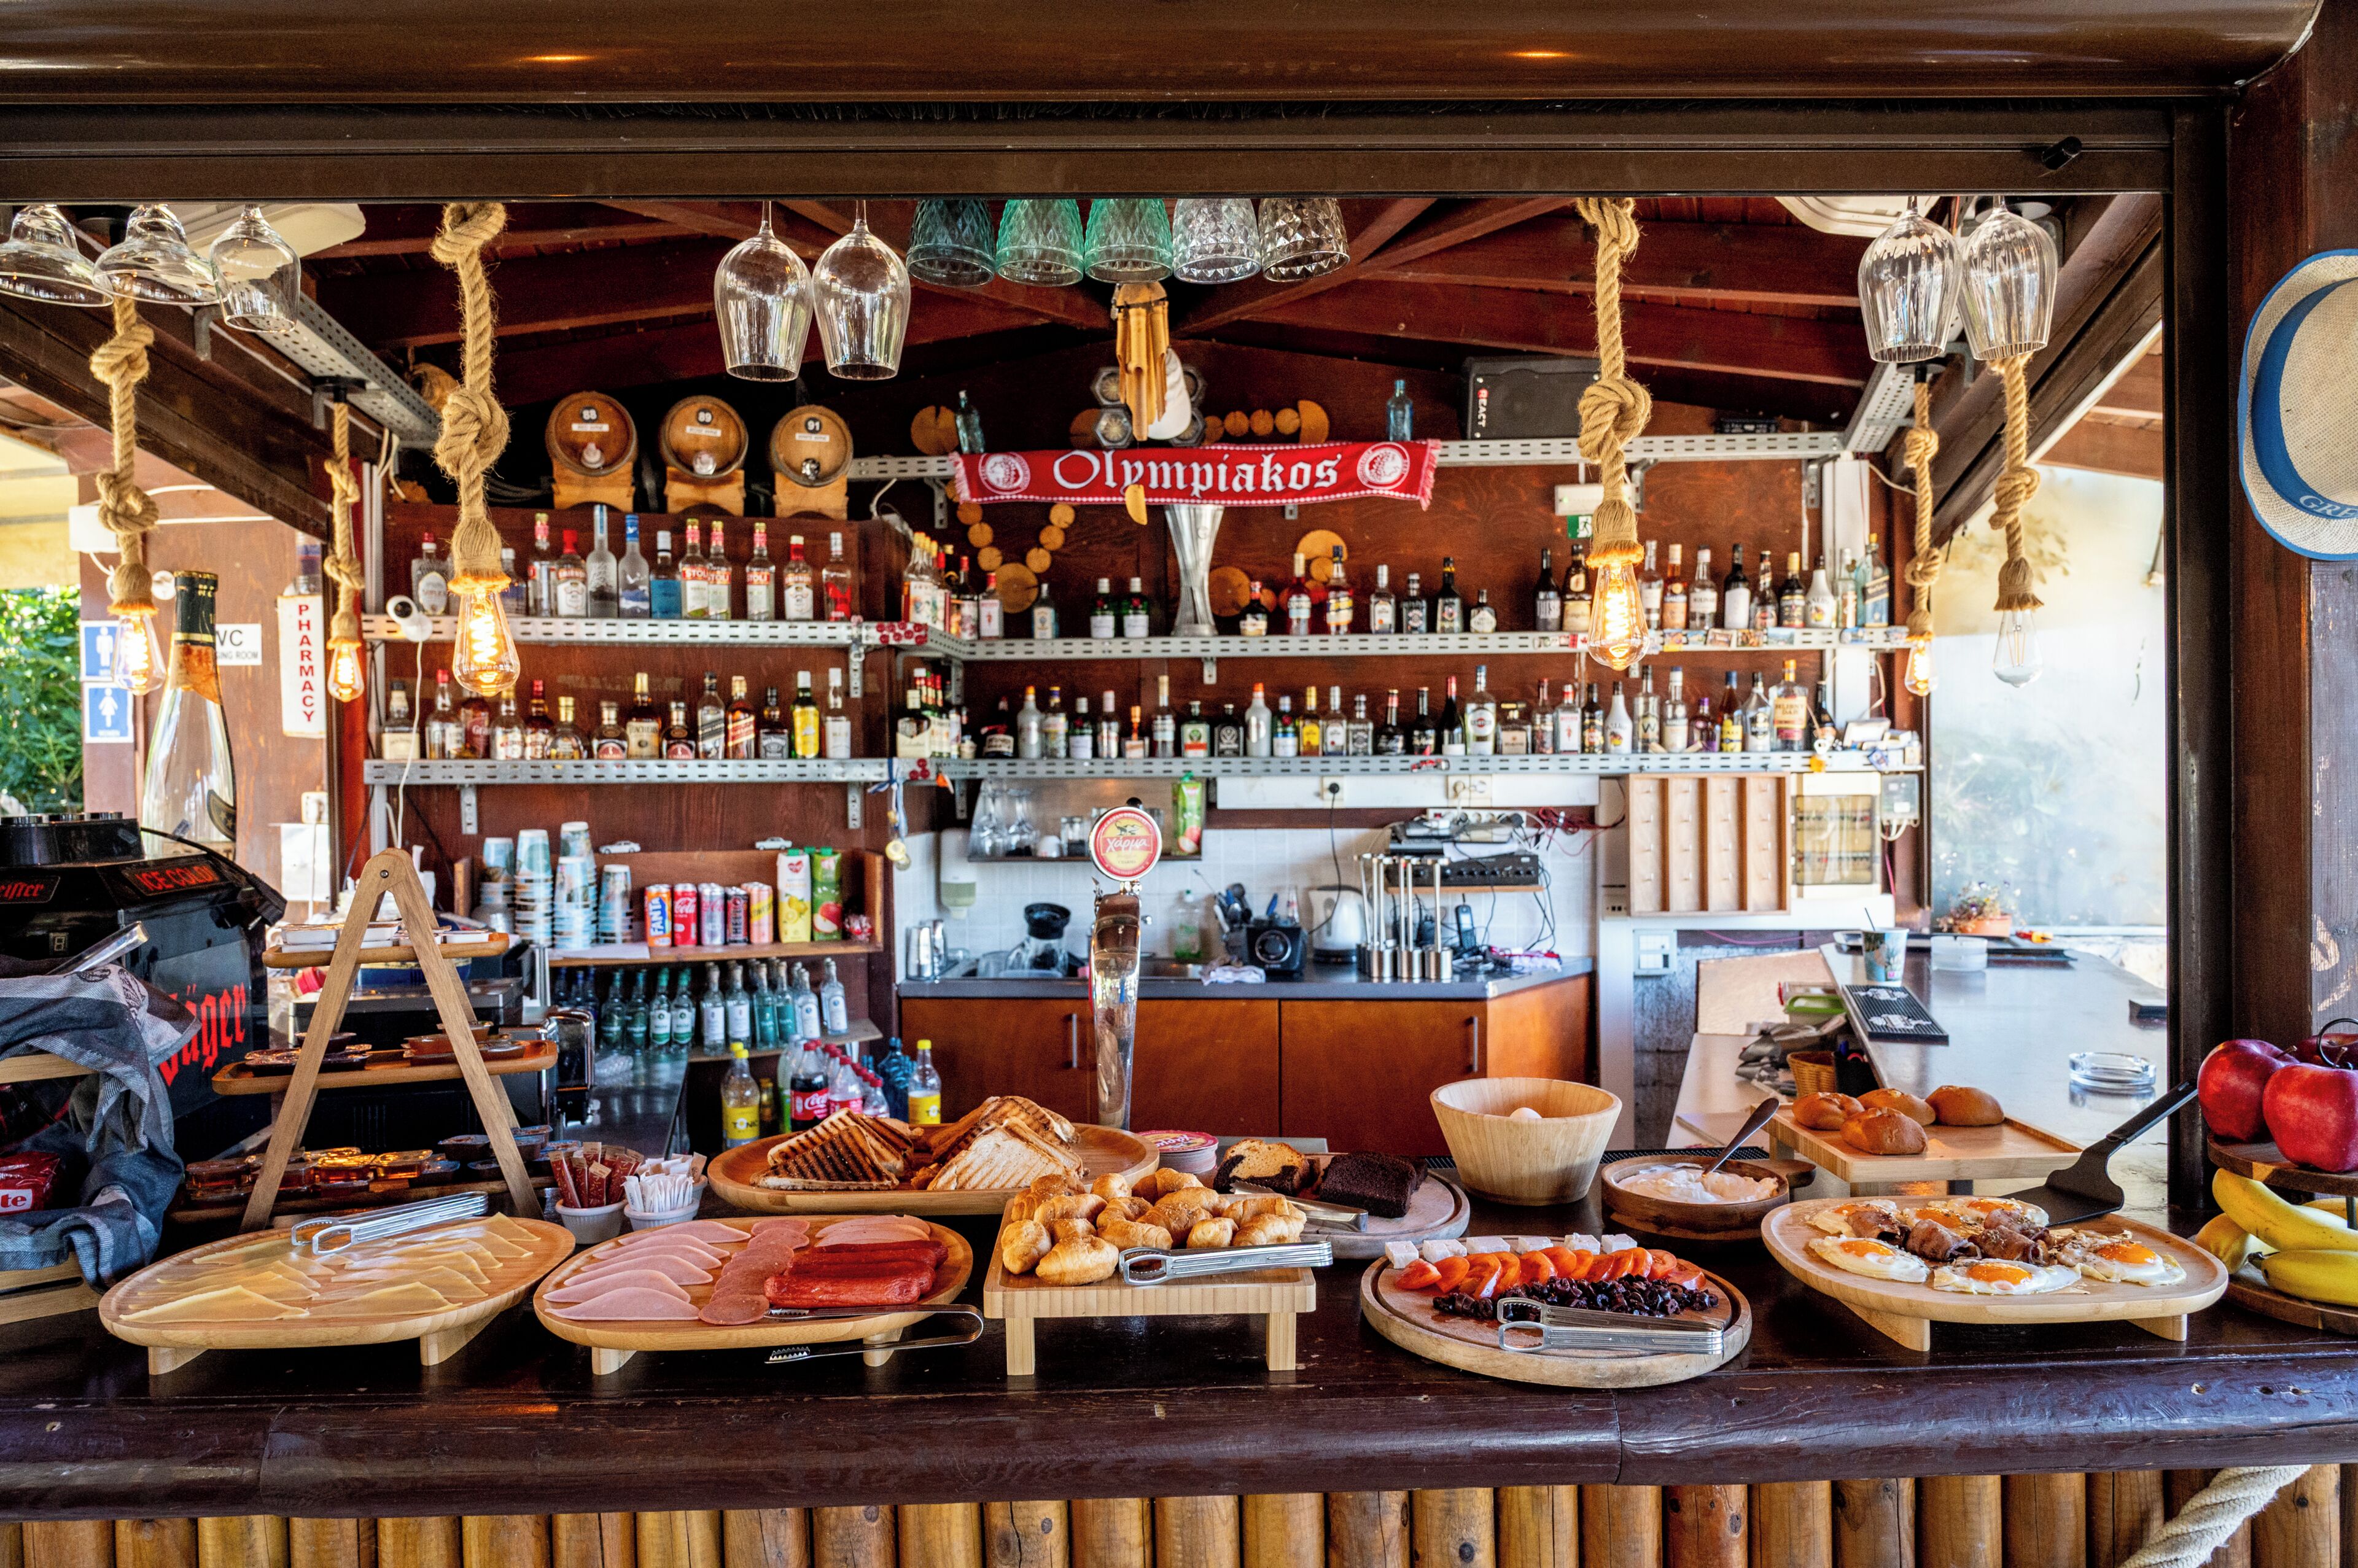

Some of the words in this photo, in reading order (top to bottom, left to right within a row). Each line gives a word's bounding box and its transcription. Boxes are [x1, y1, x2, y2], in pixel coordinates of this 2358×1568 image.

[698, 411, 712, 423] 89
[1476, 387, 1488, 429] REACT
[807, 419, 820, 431] 91
[1054, 449, 1342, 498] Olympiakos
[235, 651, 259, 660] ROOM
[298, 604, 316, 722] PHARMACY
[1106, 836, 1148, 854] Χάρμα
[134, 871, 174, 891] ICE
[648, 896, 666, 936] FANTA
